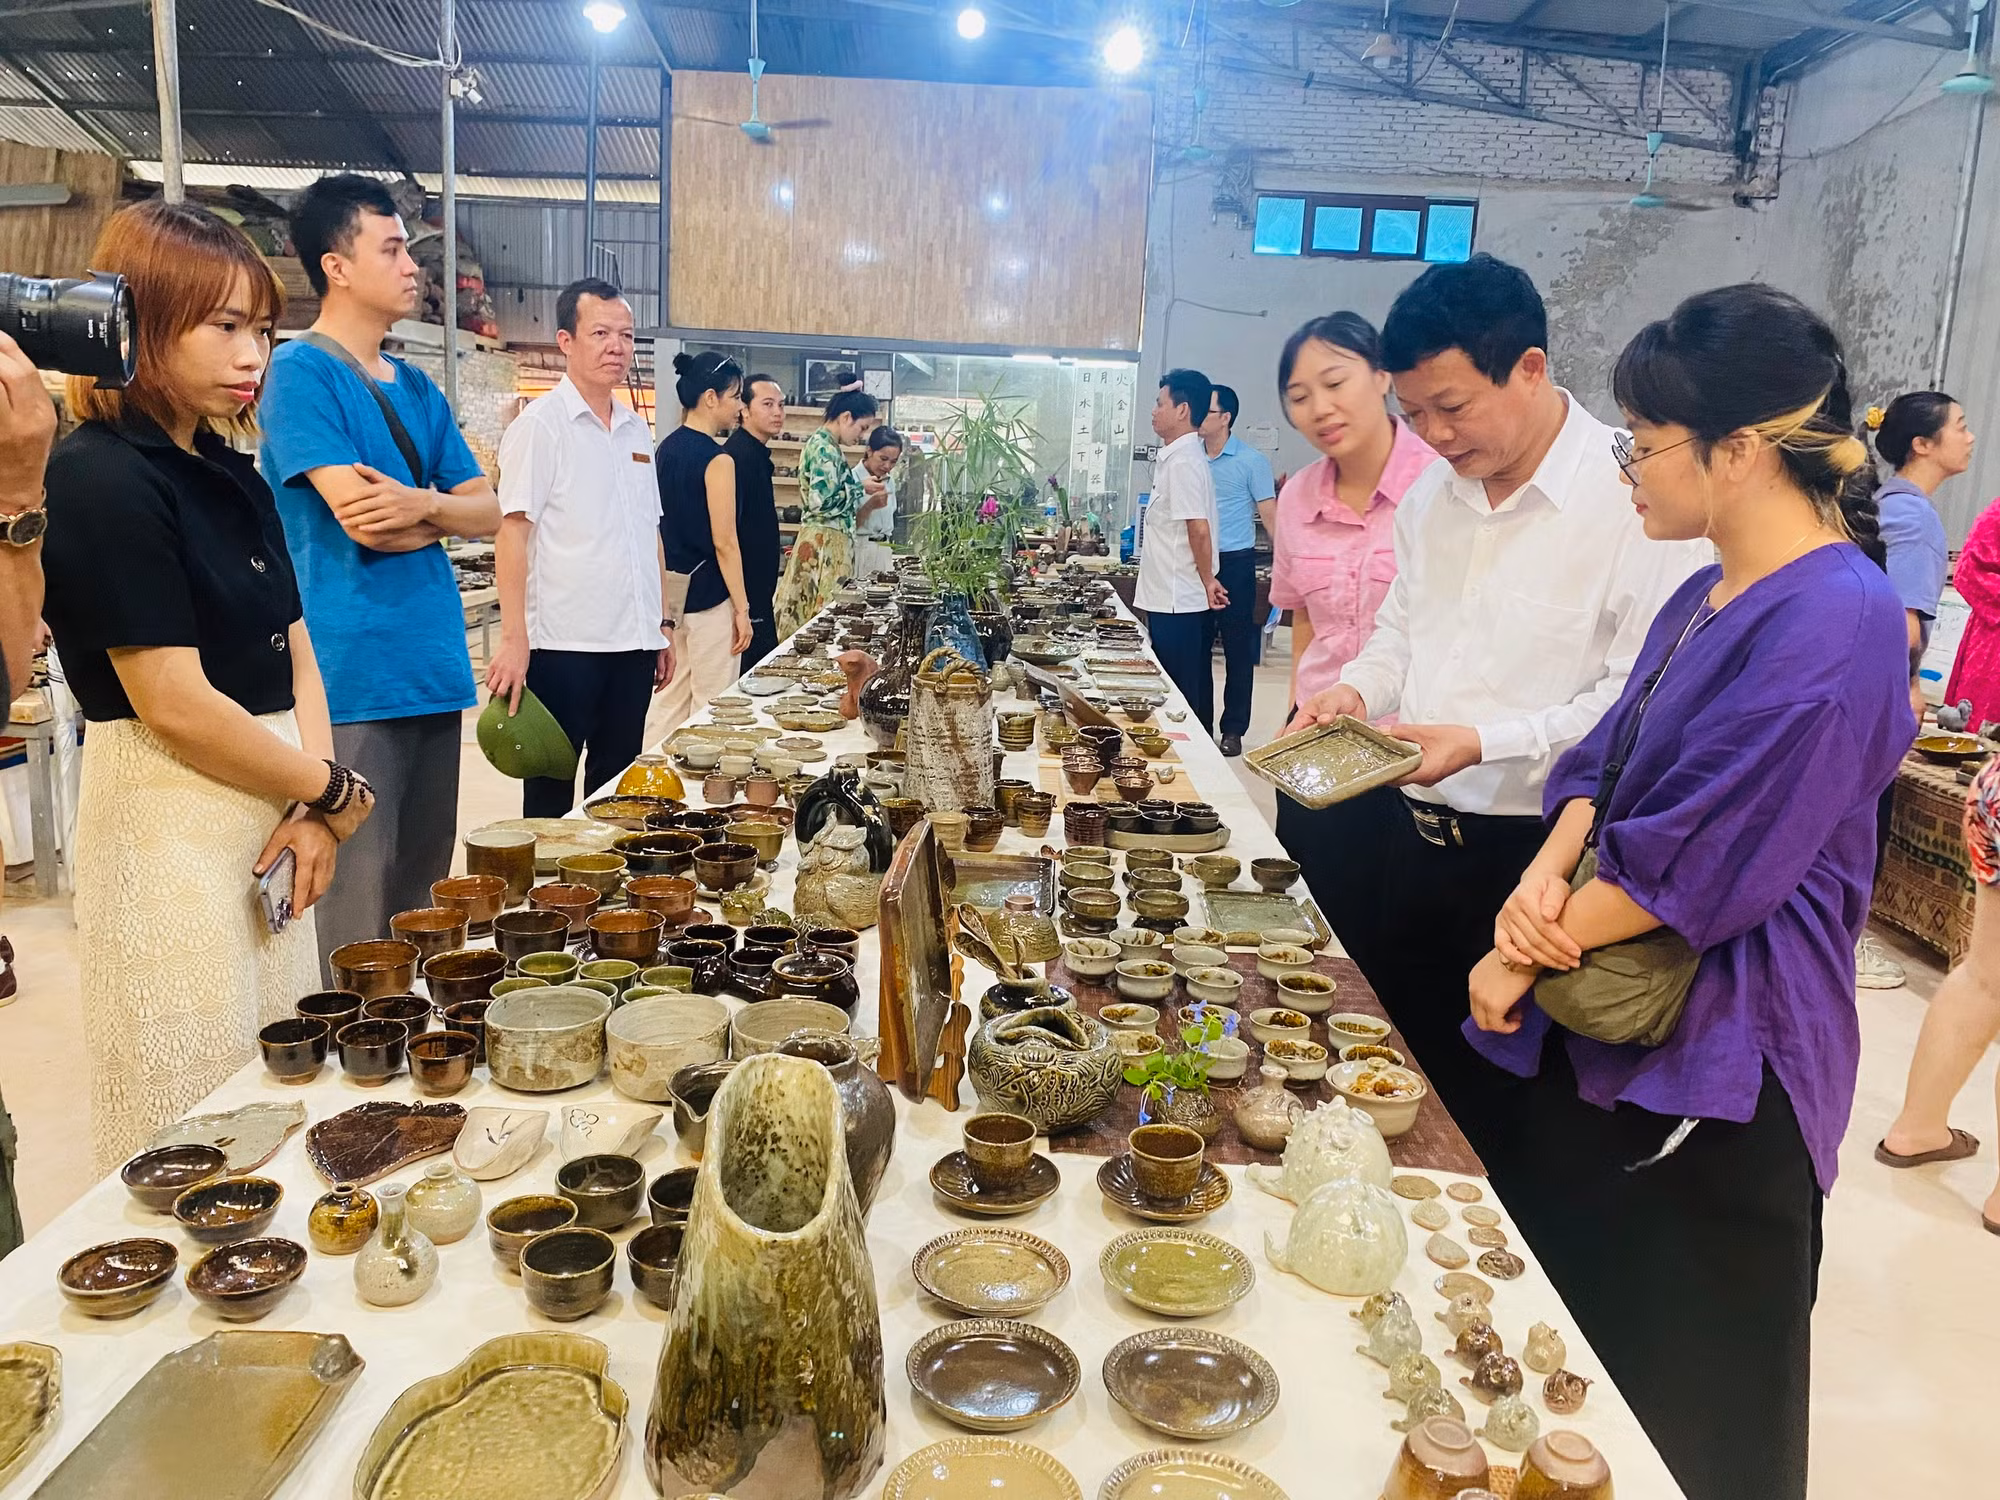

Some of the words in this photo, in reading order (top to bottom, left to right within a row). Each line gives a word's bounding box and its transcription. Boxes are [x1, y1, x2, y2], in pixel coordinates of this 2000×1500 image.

[1084, 373, 1091, 382] 日
[1101, 372, 1107, 384] 月
[1117, 373, 1129, 386] 火
[1079, 398, 1091, 408] 水
[1116, 399, 1128, 410] 金
[1077, 425, 1089, 434] 土
[1114, 424, 1124, 434] 山
[1077, 452, 1086, 462] 下
